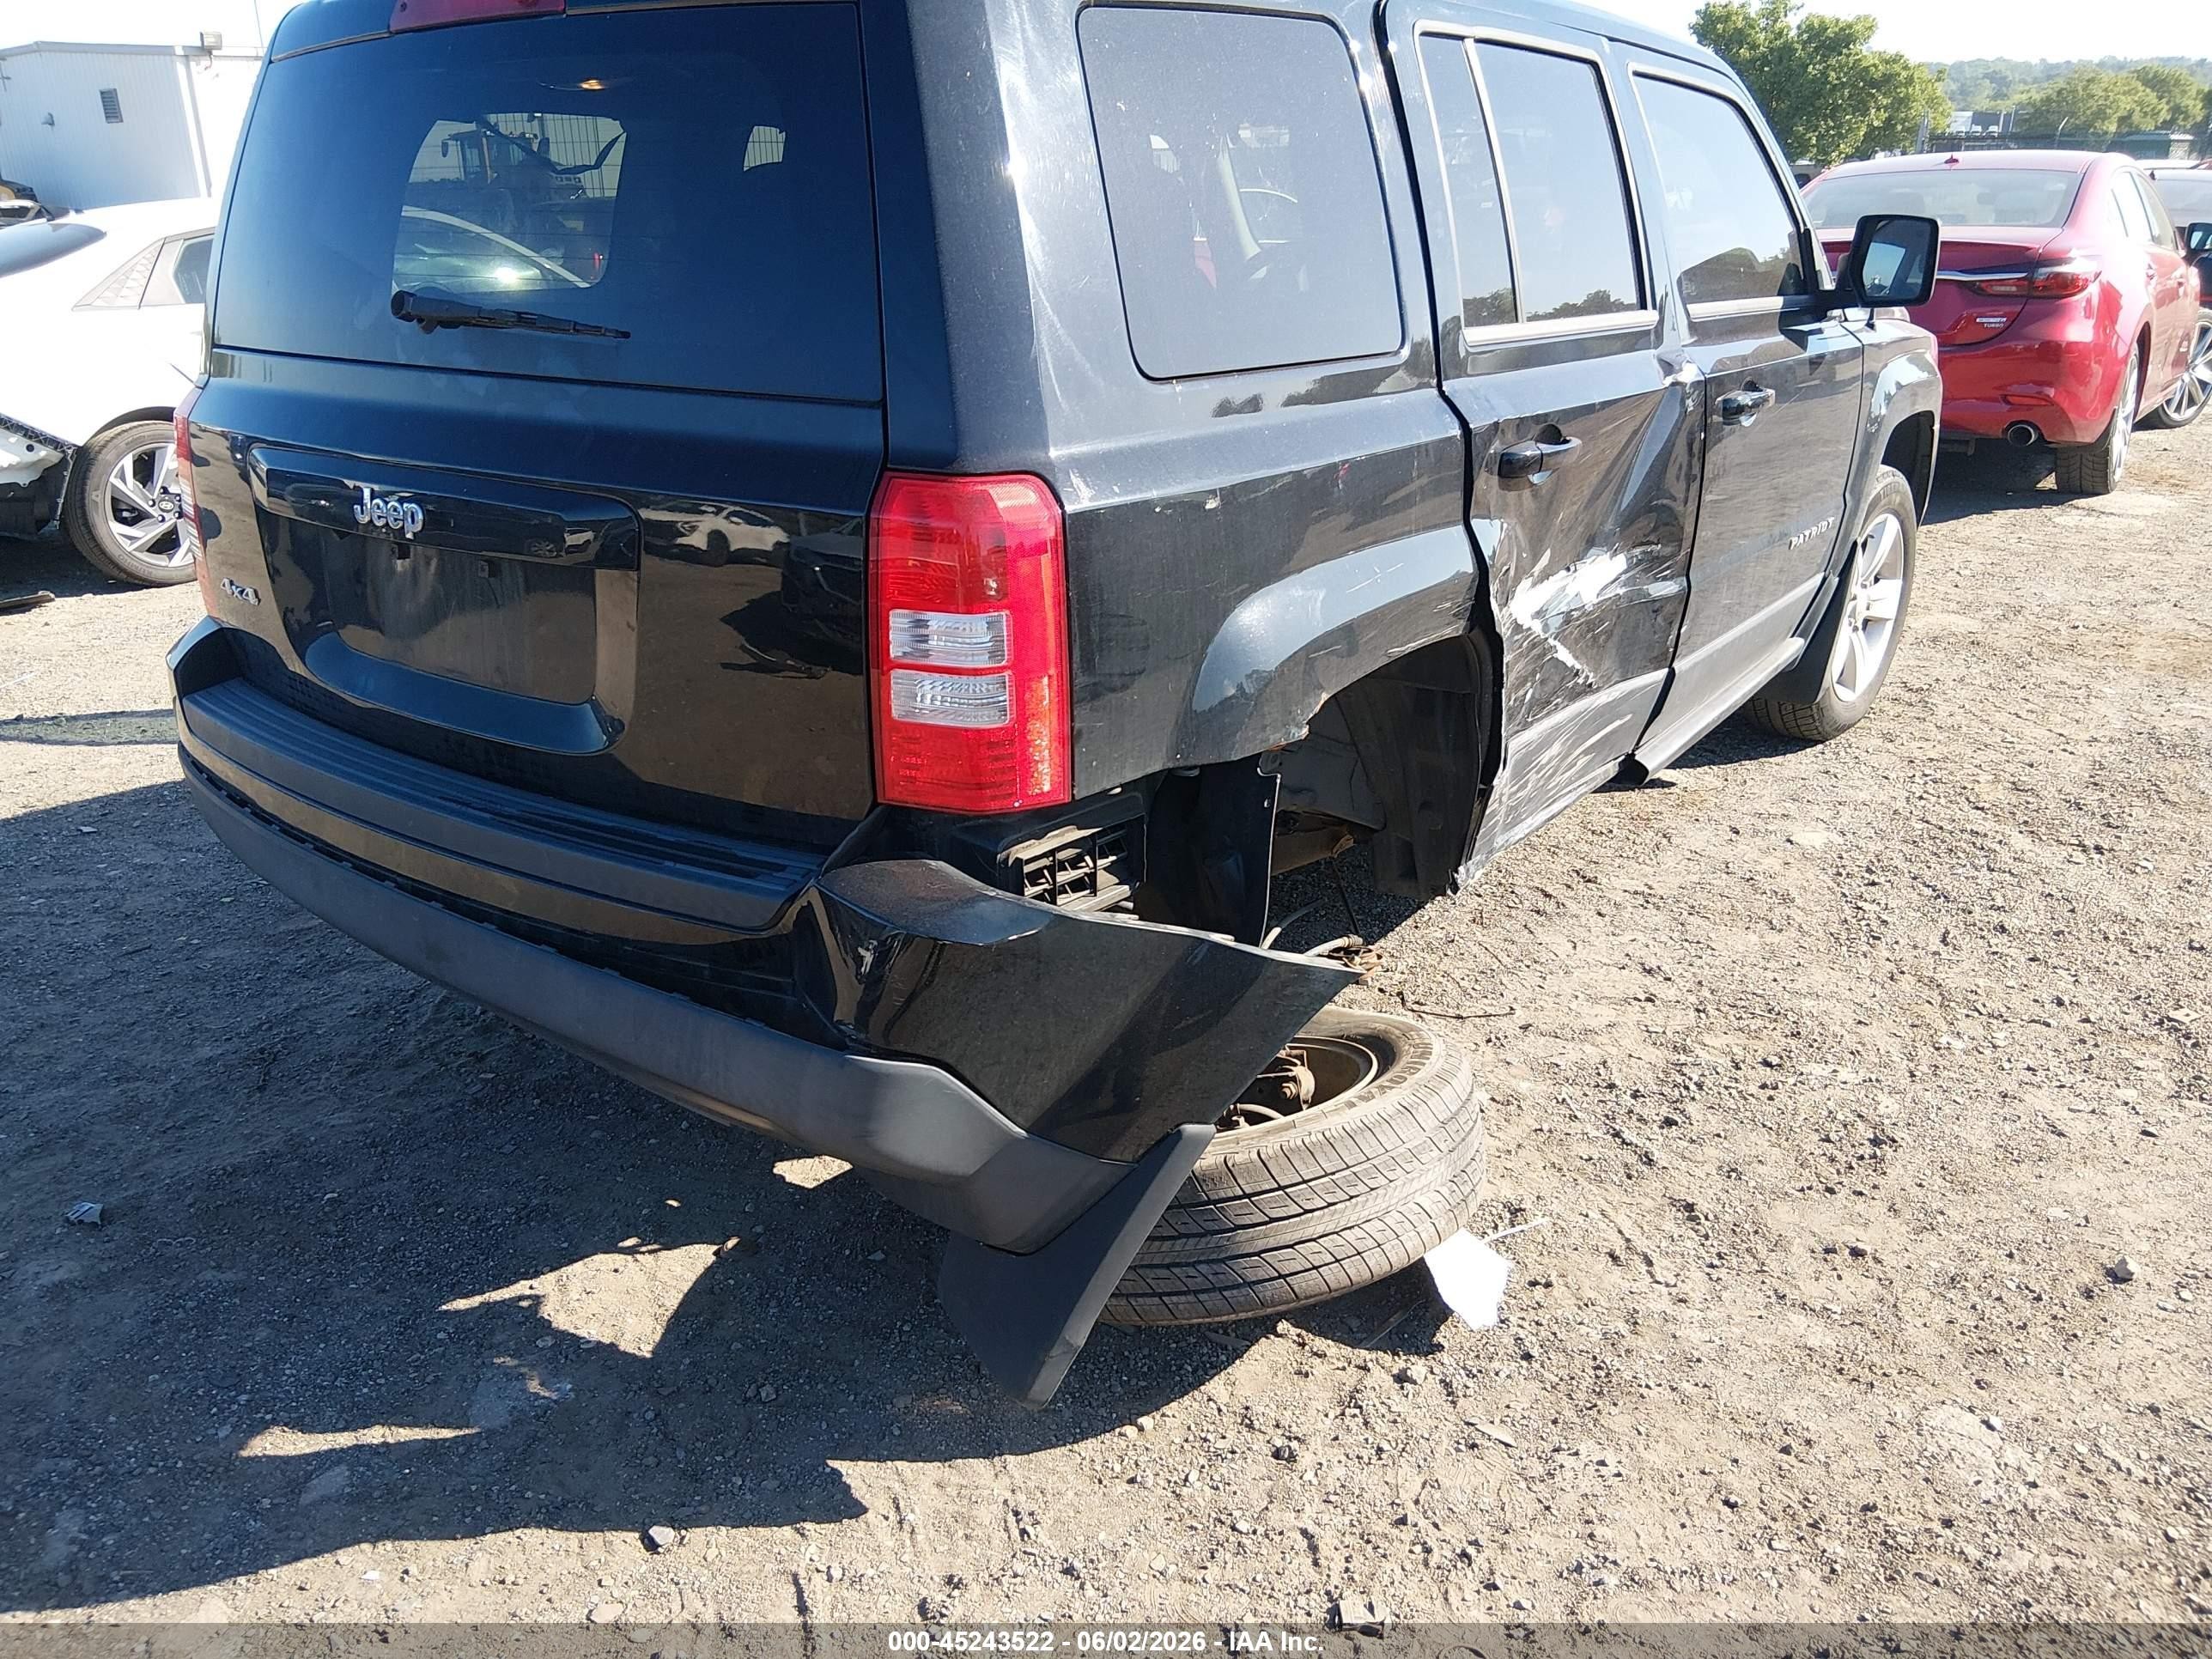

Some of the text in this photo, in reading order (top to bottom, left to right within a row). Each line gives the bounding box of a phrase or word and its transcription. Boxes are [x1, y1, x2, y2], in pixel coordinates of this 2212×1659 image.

[353, 487, 424, 540] Jeep
[1788, 516, 1835, 550] PATRIOT
[220, 577, 260, 606] 4x4
[1335, 1042, 1433, 1110] UNIROYAL
